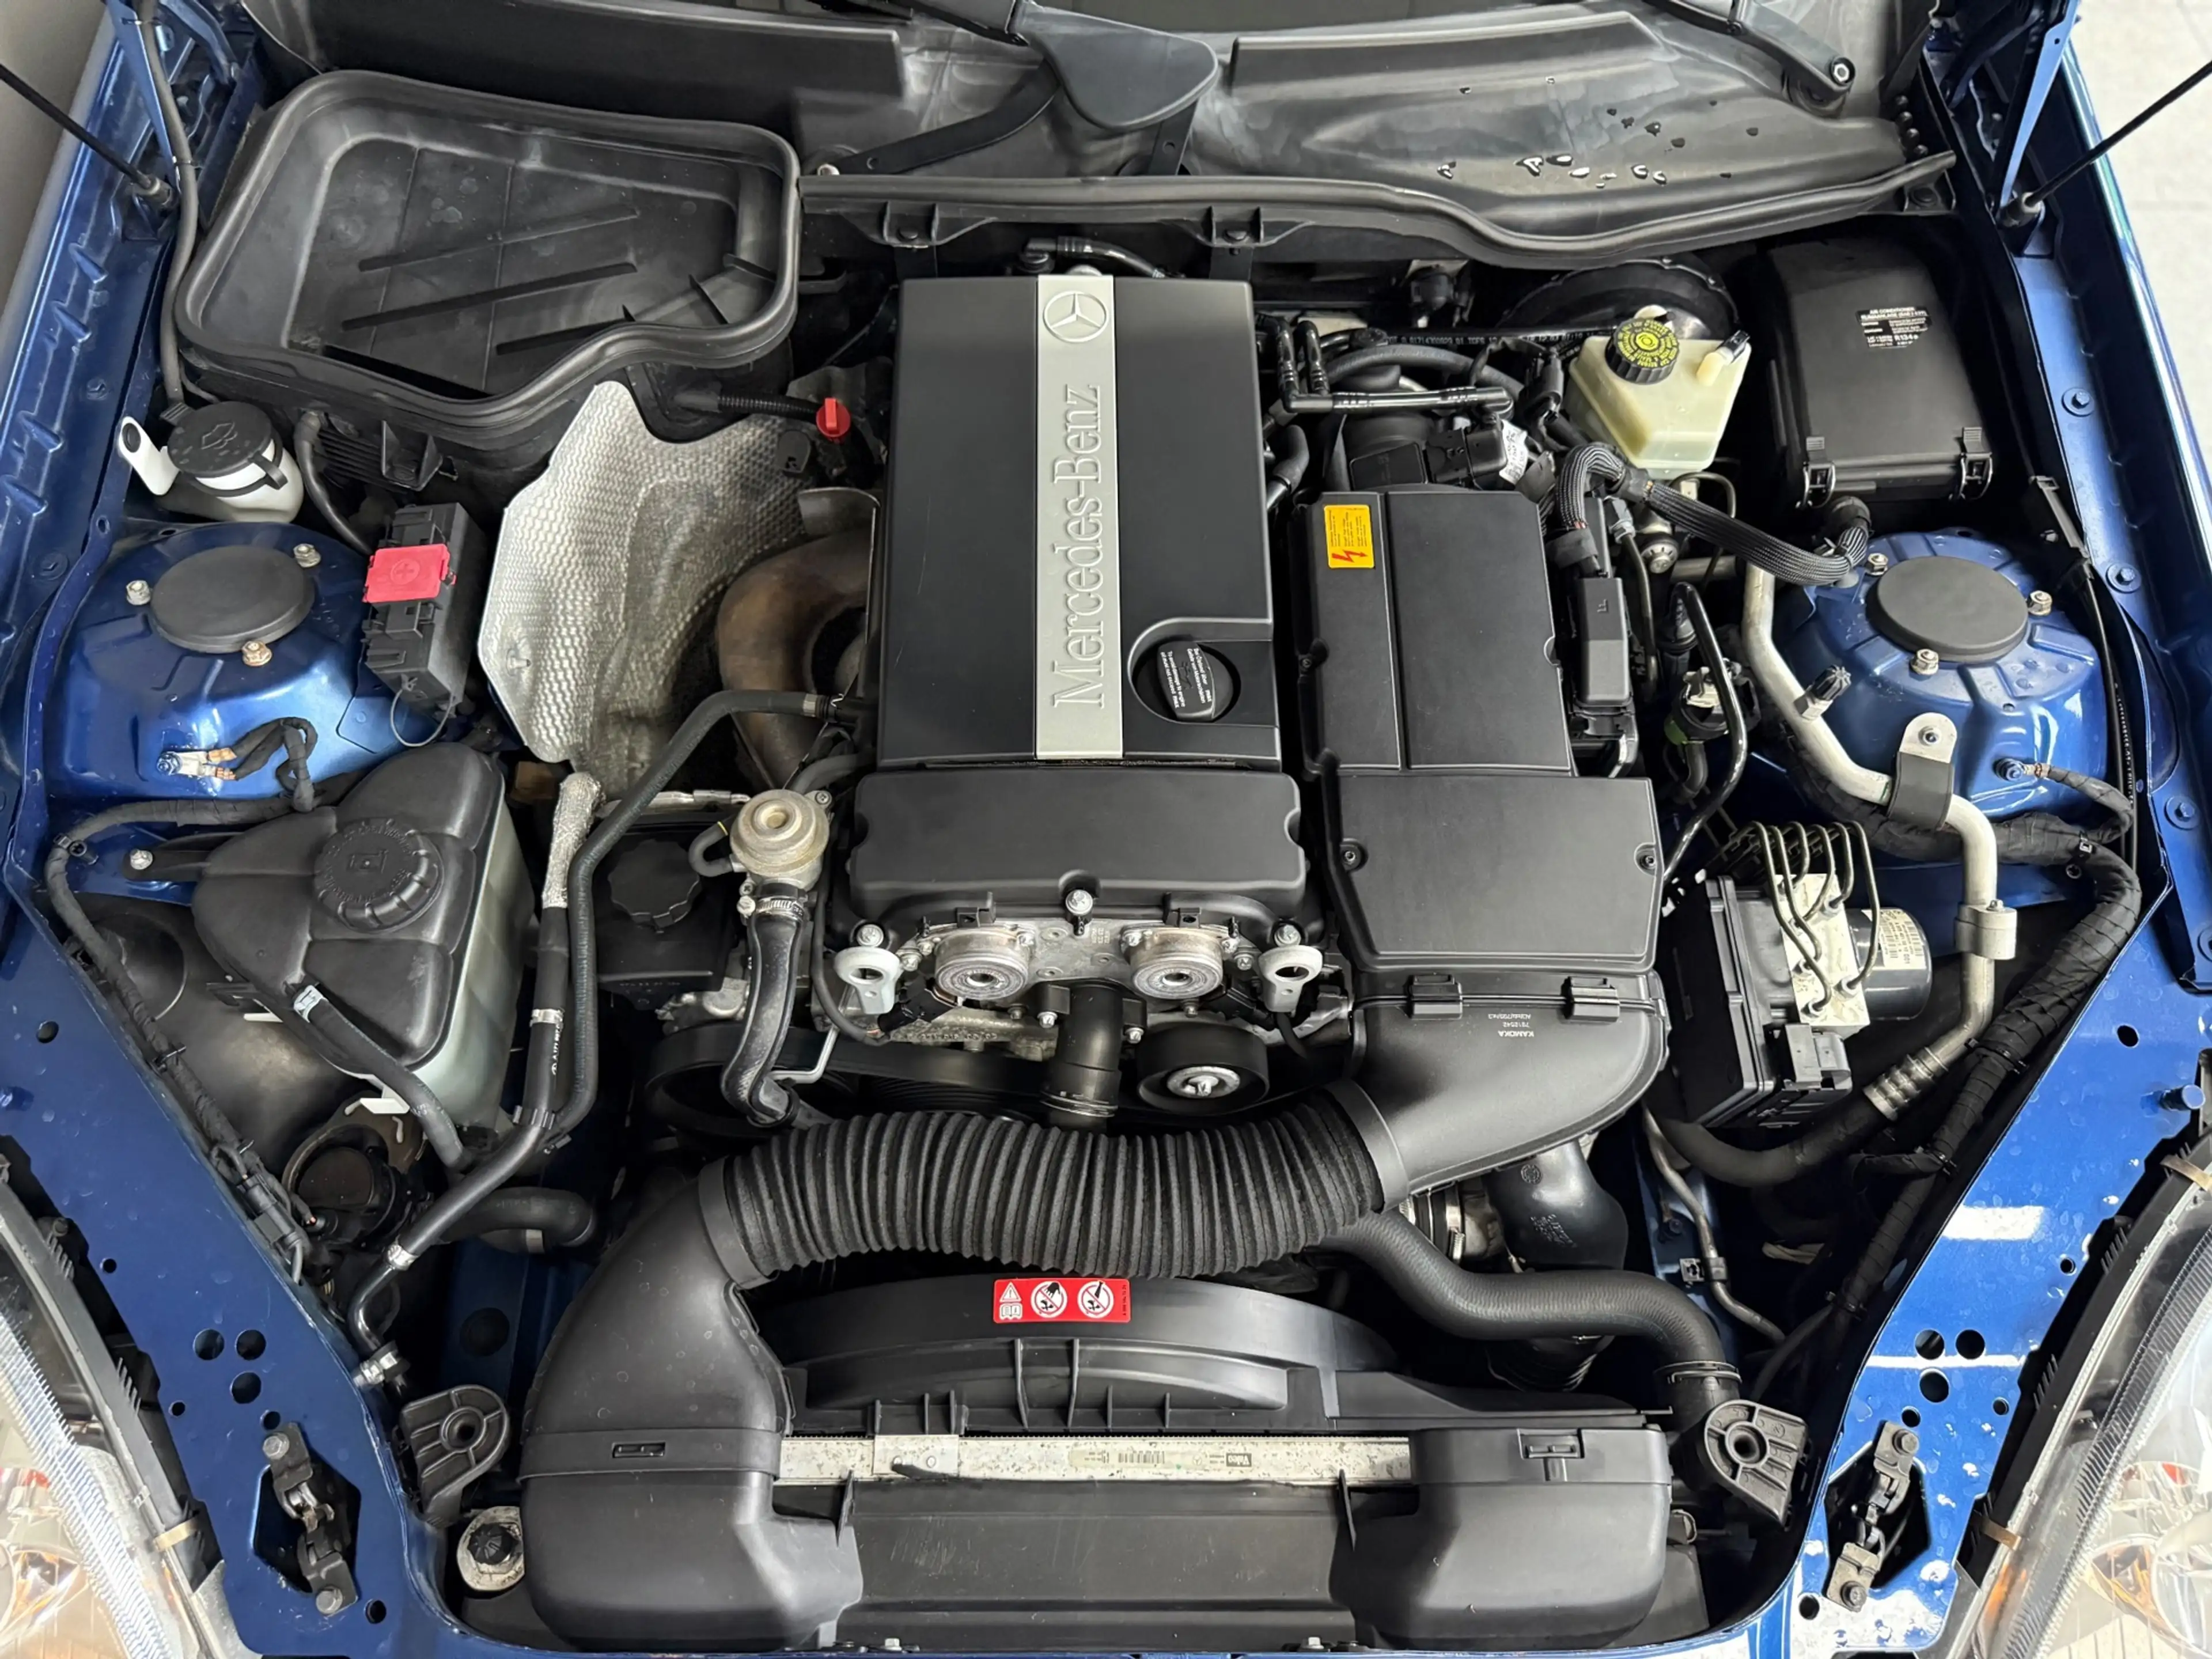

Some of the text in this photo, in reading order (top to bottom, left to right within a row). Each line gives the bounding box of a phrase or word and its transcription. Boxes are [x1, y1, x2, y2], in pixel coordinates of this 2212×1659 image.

[1054, 383, 1104, 709] Mercedes-Benz
[1166, 676, 1176, 694] exceed
[1172, 668, 1181, 685] damage
[1177, 691, 1186, 707] engine
[1228, 1455, 1250, 1465] Valeo
